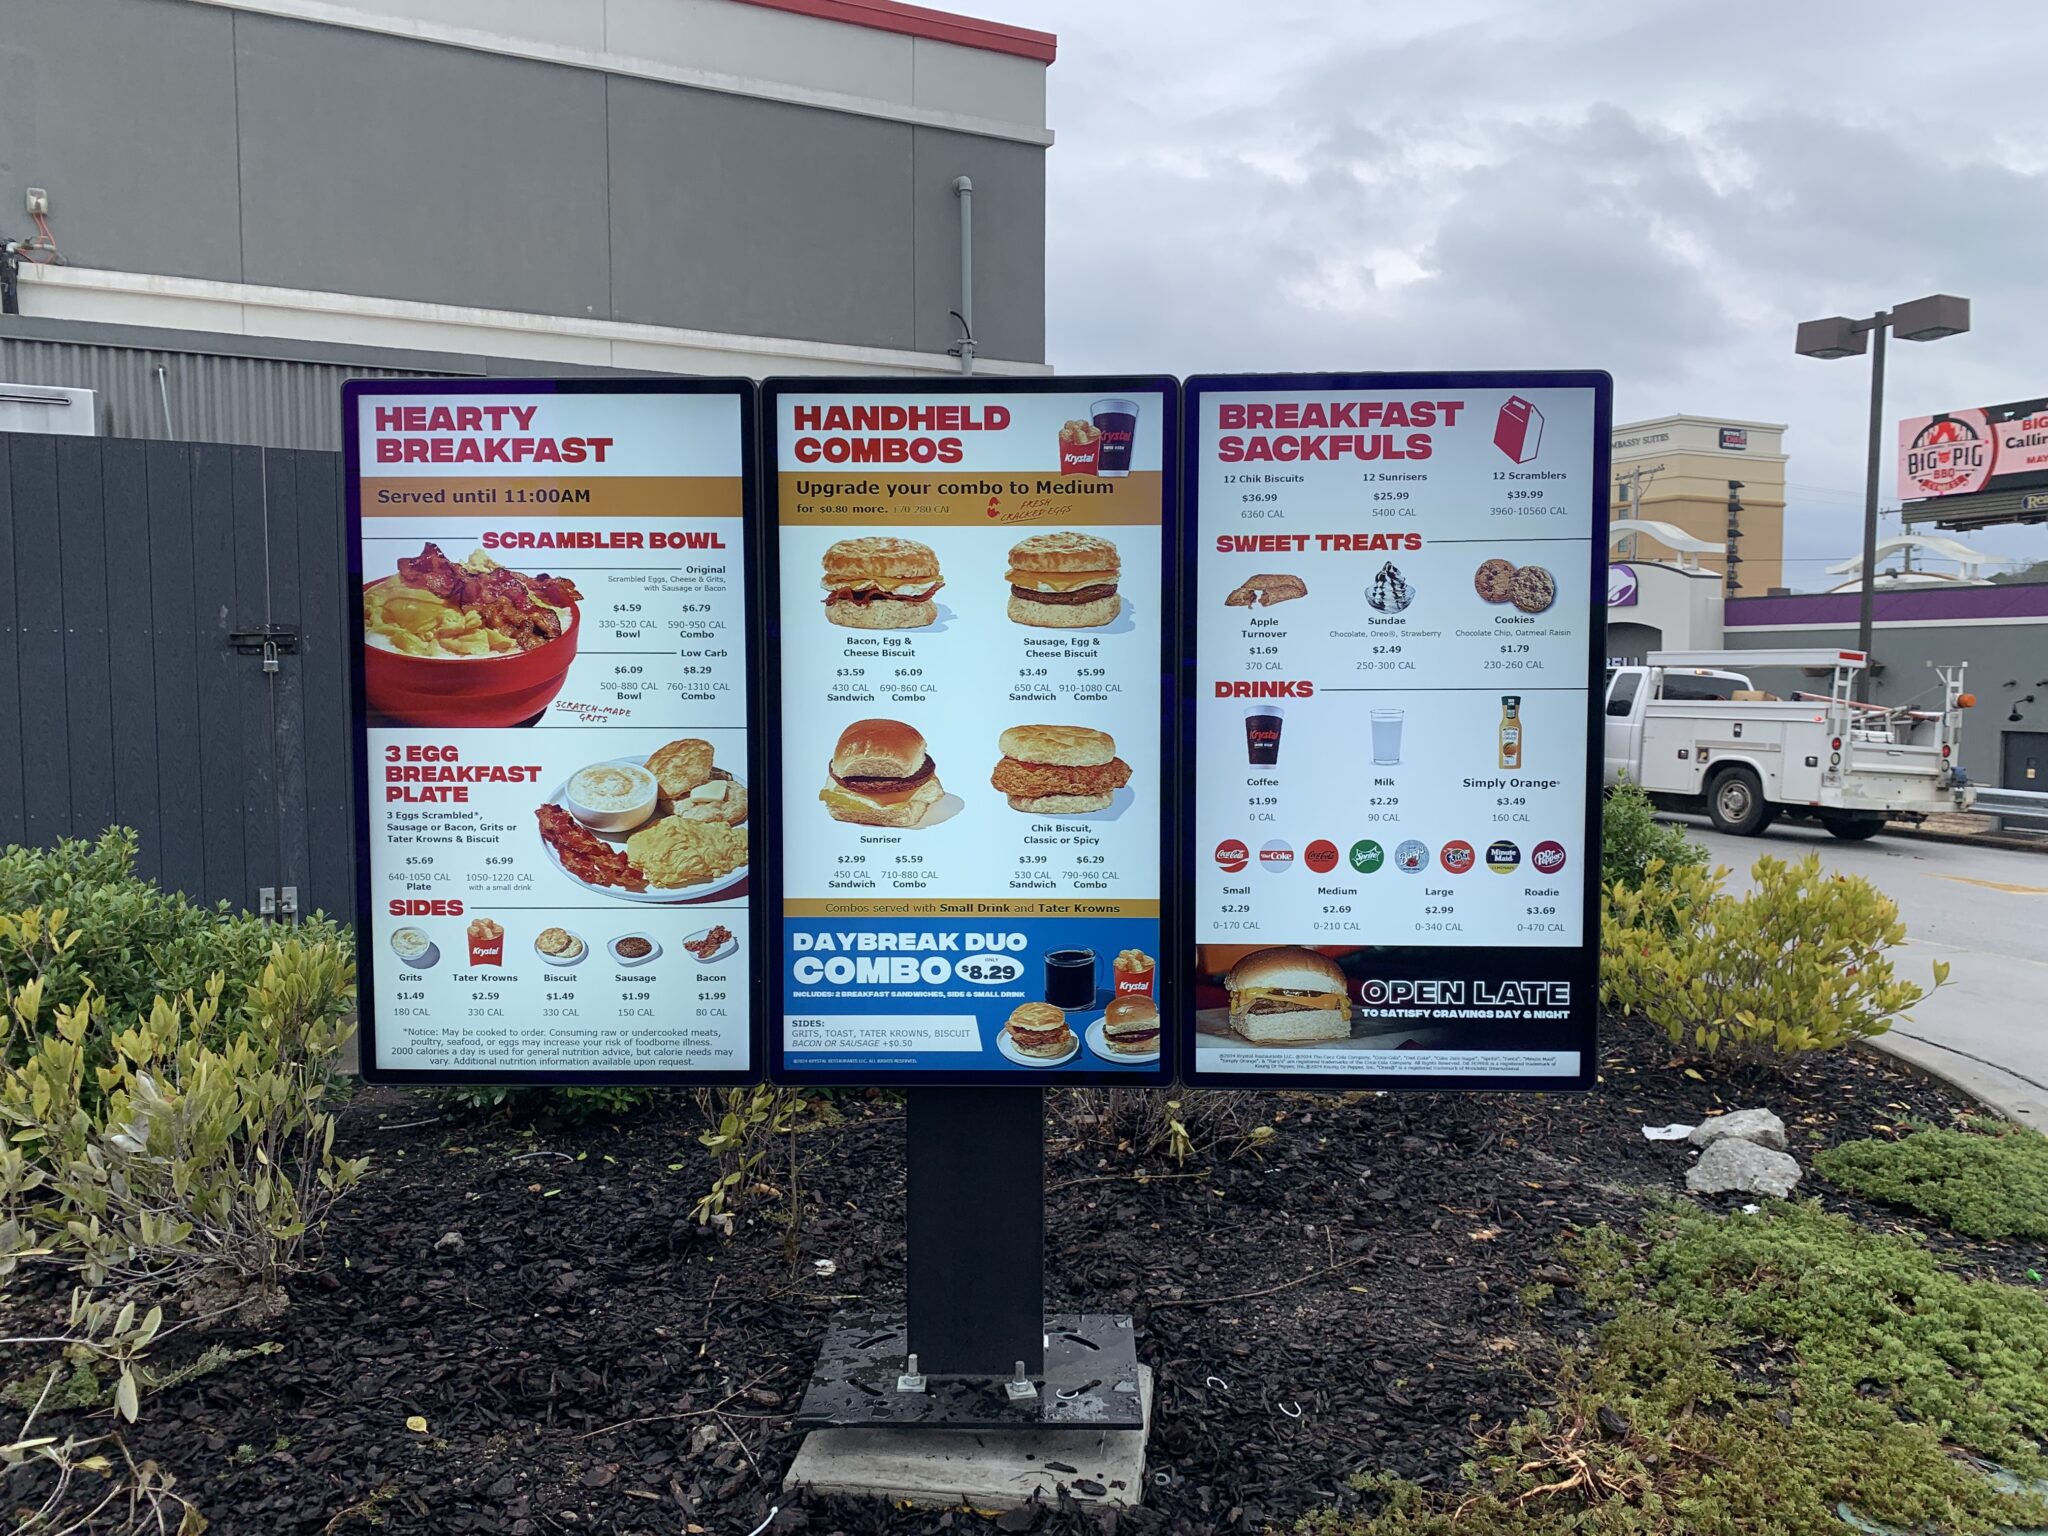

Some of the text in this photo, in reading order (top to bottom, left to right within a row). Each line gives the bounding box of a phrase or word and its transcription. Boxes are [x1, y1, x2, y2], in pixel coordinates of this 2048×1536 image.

[375, 406, 538, 431] HEARTY
[794, 405, 1010, 431] HANDHELD
[1219, 401, 1464, 429] BREAKFAST
[1642, 432, 1670, 445] SUITES
[376, 437, 613, 463] BREAKFAST
[794, 437, 963, 463] COMBOS
[1218, 434, 1432, 462] SACKFULS
[1064, 453, 1095, 465] Krystal
[1908, 444, 1983, 476] BIG PIG
[1224, 474, 1304, 483] 12 Chik Biscuits
[1379, 473, 1427, 481] Sunrisers
[1494, 471, 1567, 480] 12 Scramblers
[1933, 468, 1955, 480] BBQ
[797, 480, 1113, 497] Upgrade your combo to Medium
[378, 488, 590, 503] Served until 11:00AM
[1242, 494, 1277, 503] $36.99
[1374, 492, 1409, 501] $25.99
[1508, 491, 1543, 499] $39.99
[797, 504, 888, 513] for $0.80 more.
[1021, 499, 1052, 509] FRESH
[1000, 505, 1073, 524] CRACKED EGGS
[1241, 510, 1285, 518] 6360 CAL
[1490, 506, 1568, 515] 3960-10560 CAL
[483, 532, 726, 549] SCRAMBLER BOWL
[1216, 533, 1422, 552] SWEET TREATS
[686, 566, 725, 575] Original
[648, 576, 668, 584] Eggs,
[706, 576, 726, 584] Grits,
[613, 604, 641, 612] $4.59
[1250, 618, 1278, 627] Apple
[1495, 616, 1535, 625] Cookies
[1242, 630, 1287, 638] Turnover
[1401, 630, 1442, 638] Strawberry
[846, 637, 879, 646] Bacon,
[883, 637, 901, 646] Egg
[681, 649, 727, 657] Low Carb
[1249, 647, 1278, 655] $1.69
[1373, 646, 1401, 654] $2.49
[615, 666, 643, 674] $6.09
[837, 669, 864, 677] $3.59
[895, 669, 922, 677] $6.09
[1077, 668, 1105, 676] $5.99
[1215, 681, 1313, 698] DRINKS
[555, 700, 631, 717] SCRATCH-MADE
[579, 713, 608, 723] GRITS
[385, 745, 458, 762] 3 EGG
[385, 766, 542, 782] BREAKFAST
[1247, 778, 1279, 786] Coffee
[1375, 778, 1394, 786] Milk
[1463, 778, 1506, 789] Simply
[386, 786, 468, 802] PLATE
[387, 811, 393, 819] 3
[396, 811, 419, 821] Eggs
[1032, 824, 1091, 833] Chik Biscuit,
[1270, 851, 1292, 861] Coke
[1356, 851, 1378, 861] Sprite
[1545, 849, 1555, 857] Dr
[838, 856, 865, 864] $2.99
[1538, 853, 1562, 866] Pepper
[1318, 887, 1357, 895] Medium
[1426, 888, 1453, 897] Large
[1525, 888, 1559, 896] Roadie
[389, 899, 463, 916] SIDES
[826, 904, 1120, 912] Combos served with Small Drink and Tater Krowns
[1425, 906, 1453, 914] $2.99
[1527, 907, 1555, 915] $3.69
[793, 933, 1027, 951] DAYBREAK DUO
[472, 947, 499, 956] Krystal
[793, 956, 956, 984] COMBO
[961, 965, 1015, 980] $8.29
[615, 975, 656, 983] Sausage
[1120, 981, 1149, 992] Krystal
[397, 992, 424, 1000] $1.49
[472, 992, 499, 1000] $2.59
[1361, 979, 1570, 1005] OPEN LATE
[394, 1008, 430, 1016] 180 CAL
[1362, 1009, 1570, 1019] TO SATISFY CRAVINGS DAY & NIGHT
